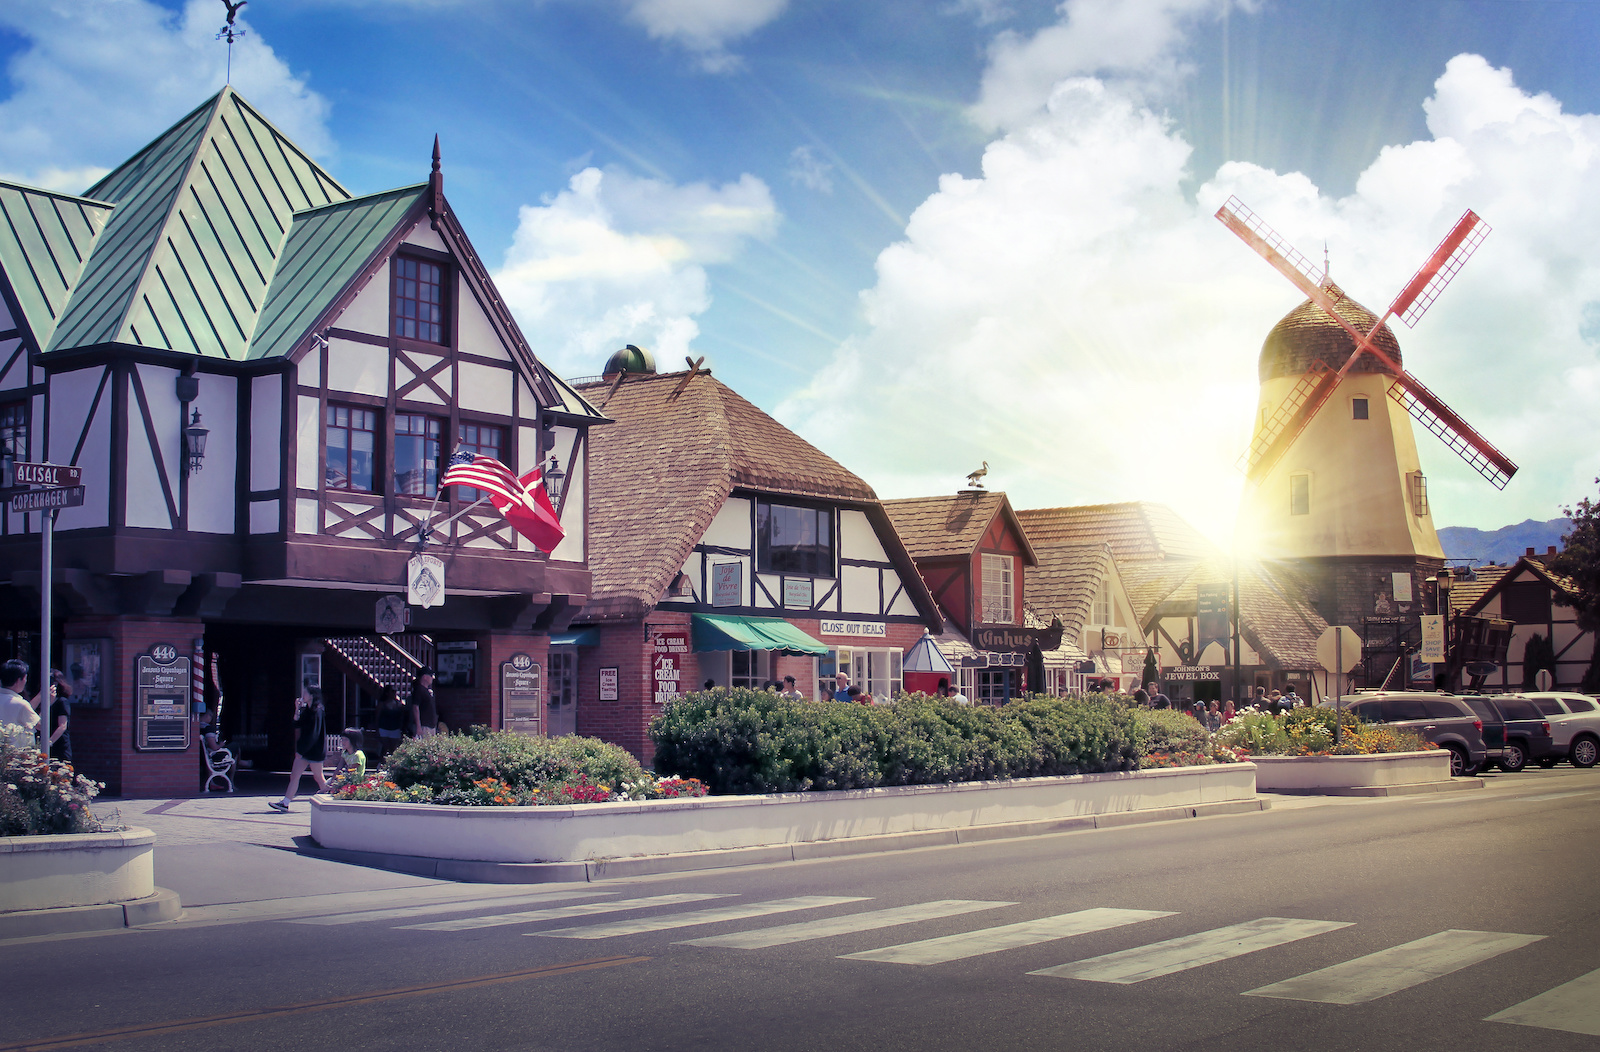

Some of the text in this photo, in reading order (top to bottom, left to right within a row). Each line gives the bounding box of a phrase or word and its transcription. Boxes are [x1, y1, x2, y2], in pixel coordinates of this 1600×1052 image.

[17, 466, 79, 484] ALISAL RD.
[12, 490, 68, 510] COPENHAGEN
[424, 556, 443, 568] SPORTS
[722, 574, 731, 582] de
[716, 582, 738, 591] Vivre
[821, 622, 884, 635] CLOSE OUT DEALS
[978, 630, 1032, 648] Vinhus
[153, 646, 175, 659] 446
[514, 657, 530, 667] 446
[661, 658, 673, 670] ICE
[155, 675, 173, 683] Square
[654, 669, 680, 680] CREAM
[1165, 671, 1220, 680] JEWEL BOX
[658, 681, 676, 692] FOOD
